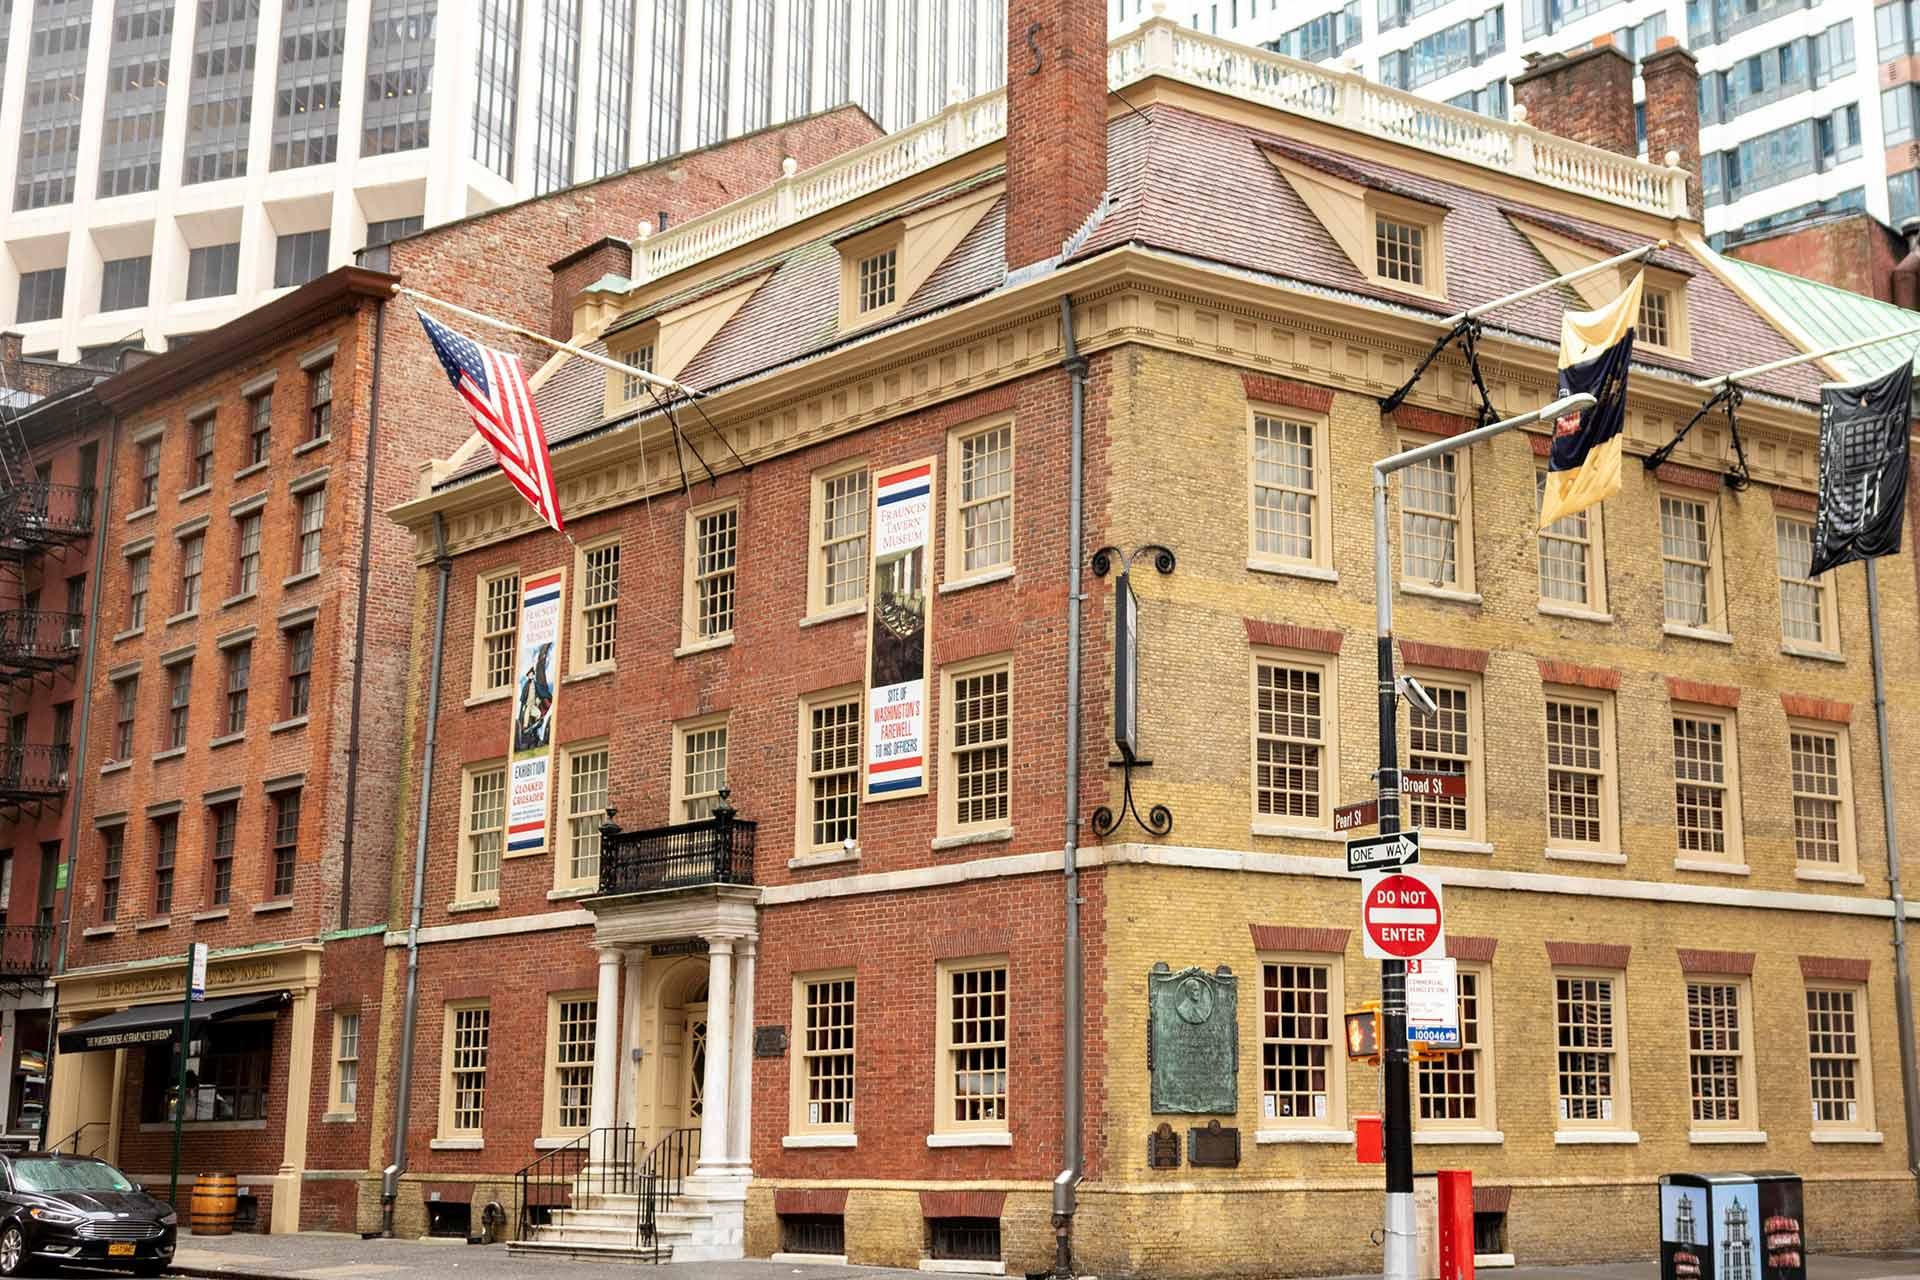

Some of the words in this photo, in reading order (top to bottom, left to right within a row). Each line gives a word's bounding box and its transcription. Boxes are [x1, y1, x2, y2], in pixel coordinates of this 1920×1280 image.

[881, 503, 927, 522] FRAUNCES
[886, 517, 921, 534] TAVERN
[881, 530, 922, 549] MUSEUM
[888, 688, 899, 703] SITE
[900, 687, 907, 700] OF
[874, 701, 920, 722] WASHINGTON'S
[881, 723, 912, 739] FAREWELL
[876, 744, 882, 757] TO
[883, 742, 892, 756] HIS
[893, 739, 918, 755] OFFICERS
[514, 760, 545, 779] EXHIBITION
[1403, 777, 1429, 793] Broad
[1433, 778, 1442, 794] St
[1336, 812, 1352, 830] Pearl
[1354, 809, 1361, 826] St
[1353, 848, 1374, 861] ONE
[1386, 843, 1408, 857] WAY
[1377, 890, 1395, 904] DO
[1401, 891, 1426, 904] NOT
[1382, 928, 1425, 942] ENTER
[1410, 960, 1419, 973] 3
